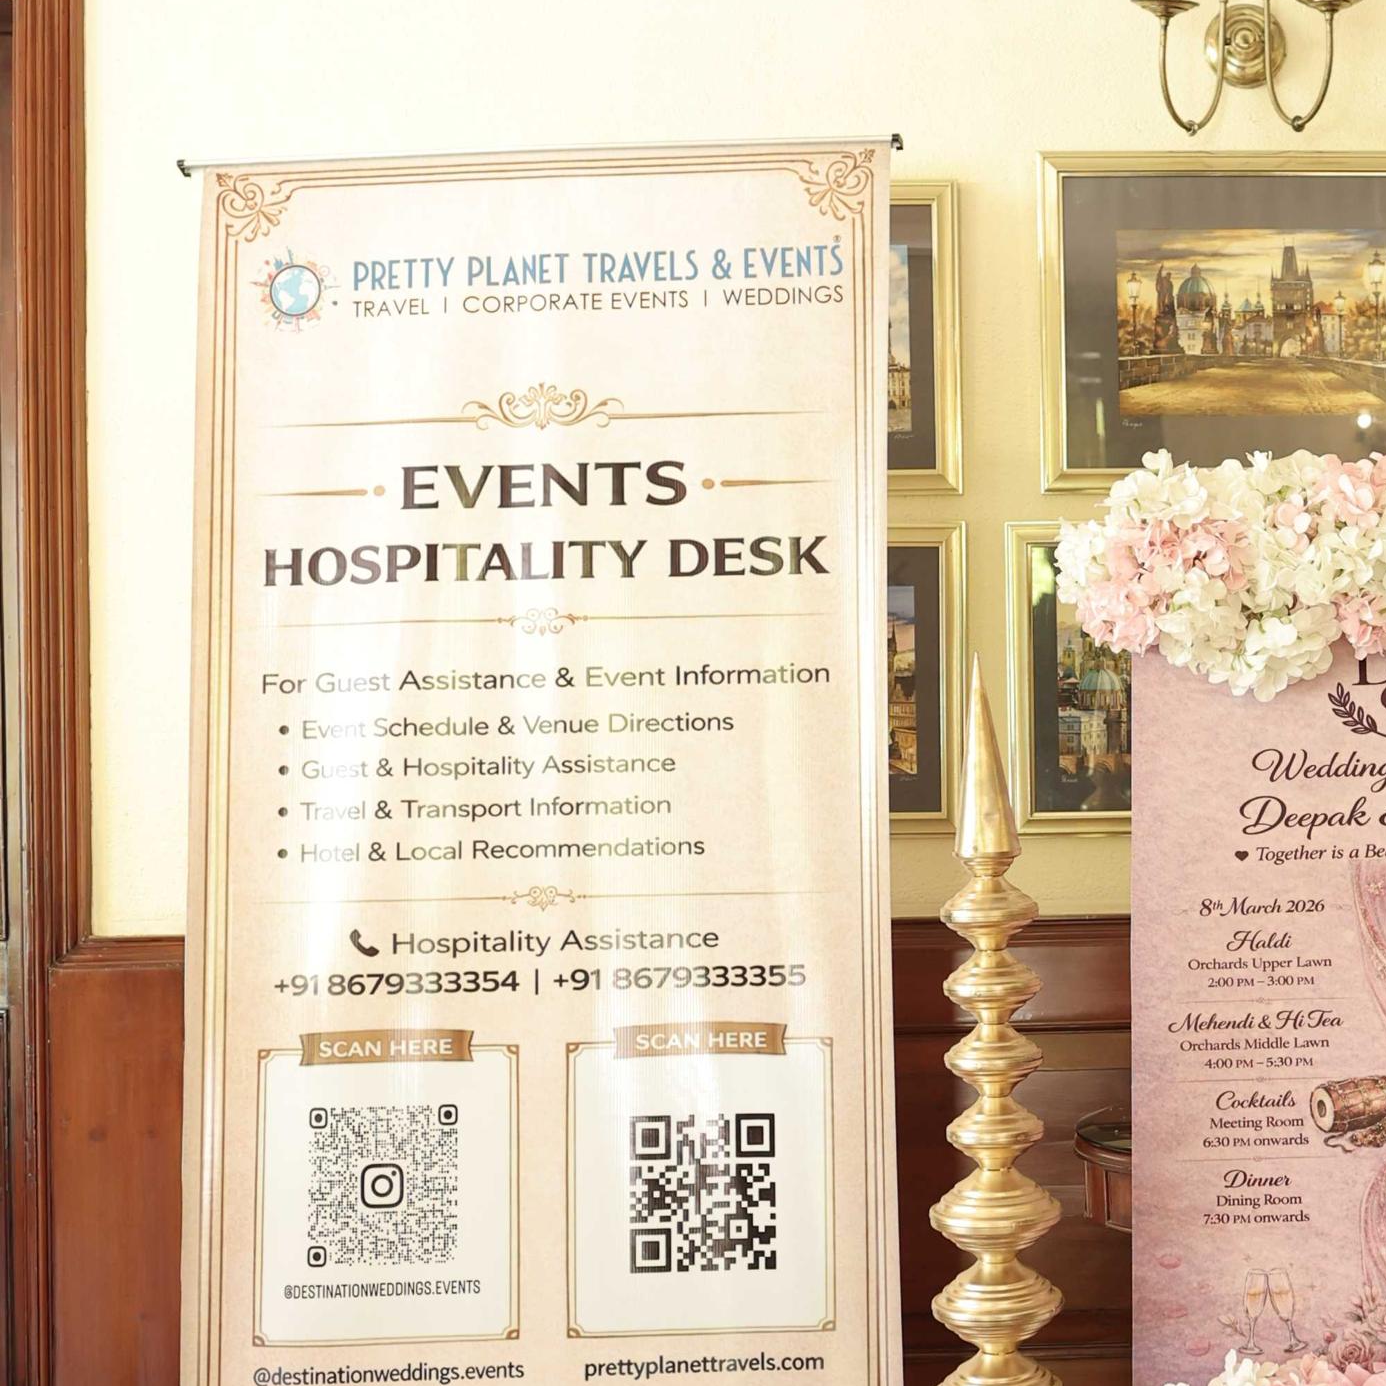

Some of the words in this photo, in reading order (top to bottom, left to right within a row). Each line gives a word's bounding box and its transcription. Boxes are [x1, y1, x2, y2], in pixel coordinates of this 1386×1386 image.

[352, 256, 455, 292] PRETTY
[466, 252, 571, 288] PLANET
[582, 249, 699, 284] TRAVELS
[710, 247, 732, 280] &
[742, 244, 845, 279] EVENTS
[352, 297, 430, 318] TRAVEL
[462, 292, 604, 315] CORPORATE
[611, 290, 690, 311] EVENTS
[722, 284, 845, 307] WEDDINGS
[401, 460, 688, 511] EVENTS
[263, 539, 649, 588] HOSPITALITY
[667, 534, 832, 578] DESK
[261, 672, 308, 696] For
[315, 671, 392, 695] Guest
[398, 668, 548, 693] Assistance
[554, 666, 577, 690] &
[584, 665, 667, 690] Event
[674, 662, 831, 687] Information
[301, 718, 368, 741] Event
[372, 715, 490, 739] Schedule
[496, 714, 516, 737] &
[521, 713, 600, 736] Venue
[607, 711, 735, 734] Directions
[301, 758, 369, 781] Guest
[375, 757, 395, 778] &
[401, 755, 536, 781] Hospitality
[541, 752, 677, 776] Assistance
[300, 800, 367, 822] Travel
[374, 799, 394, 821] &
[400, 797, 523, 823] Transport
[528, 794, 672, 819] Information
[1238, 794, 1372, 841] Deepak
[300, 842, 361, 864] Hotel
[367, 840, 388, 863] &
[394, 839, 464, 862] Local
[472, 835, 706, 861] Recommendations
[1255, 845, 1328, 866] Together
[1330, 844, 1345, 860] is
[1348, 848, 1360, 860] a
[1219, 896, 1282, 917] March
[1285, 898, 1325, 914] 2026
[391, 929, 553, 959] Hospitality
[559, 928, 720, 953] Assistance
[1225, 929, 1293, 952] Haldi
[1187, 957, 1249, 971] Orchards
[1251, 957, 1293, 973] Upper
[1295, 956, 1333, 969] Lawn
[611, 963, 808, 990] 8679333355
[1207, 976, 1235, 989] 2:00
[1236, 978, 1255, 987] PM
[1266, 975, 1295, 987] 3:00
[1296, 976, 1315, 986] PM
[1167, 1012, 1255, 1034] Mehendi
[1257, 1014, 1272, 1030] &
[1274, 1009, 1306, 1031] Hi
[1306, 1009, 1345, 1030] Tea
[318, 1036, 382, 1058] SCAN
[389, 1035, 454, 1057] HERE
[634, 1032, 701, 1052] SCAN
[708, 1030, 768, 1050] HERE
[1179, 1038, 1241, 1052] Orchards
[1244, 1037, 1291, 1051] Middle
[1293, 1036, 1330, 1049] Lawn
[1203, 1057, 1233, 1070] 4:00
[1235, 1058, 1254, 1068] PM
[1265, 1056, 1293, 1068] 5:30
[1295, 1056, 1314, 1067] PM
[1215, 1089, 1297, 1111] Cocktails
[1209, 1116, 1263, 1132] Meeting
[1265, 1115, 1305, 1128] Room
[1202, 1136, 1231, 1149] 6:30
[1232, 1137, 1251, 1147] PM
[1253, 1133, 1310, 1146] onwards
[1223, 1168, 1292, 1189] Dinner
[1215, 1194, 1261, 1210] Dining
[1263, 1193, 1303, 1206] Room
[1203, 1213, 1231, 1226] 7:30
[1232, 1214, 1252, 1225] PM
[1253, 1209, 1311, 1223] onwards
[283, 1278, 482, 1301] @DESTINATIONWEDDINGS.EVENTS
[583, 1351, 826, 1382] prettyplanettravels.com
